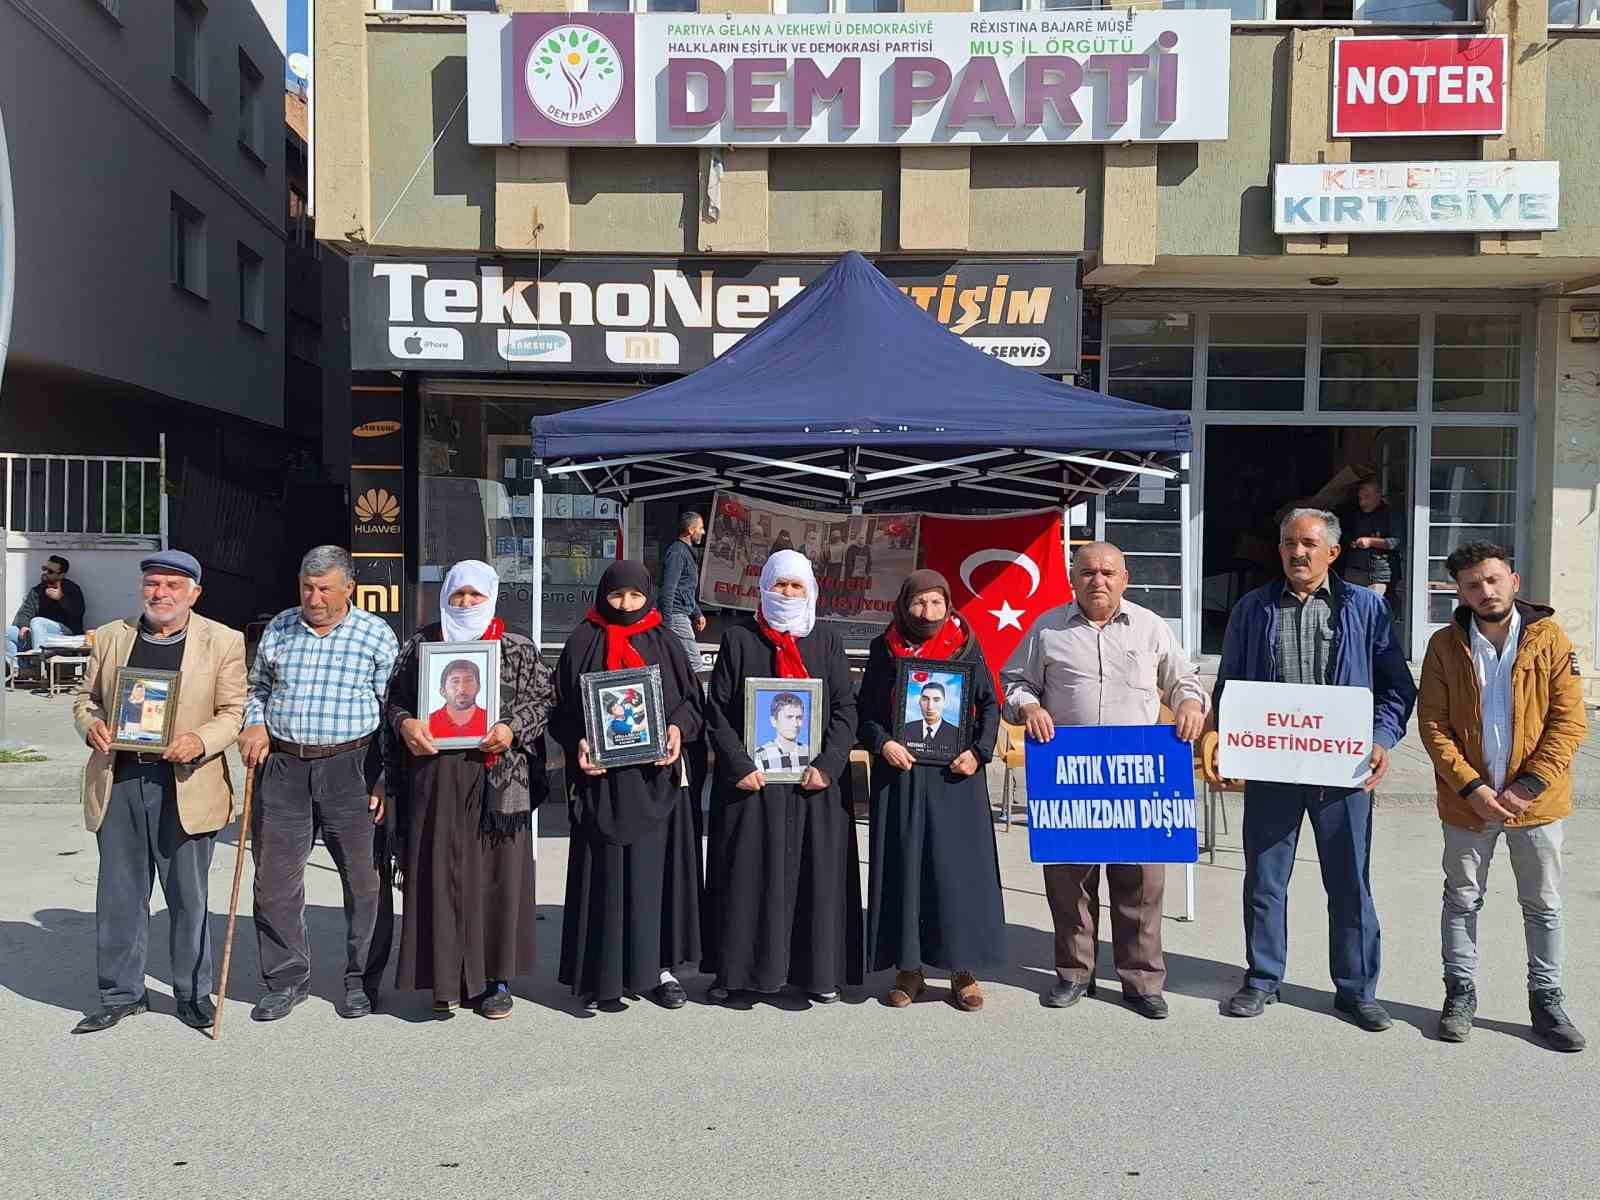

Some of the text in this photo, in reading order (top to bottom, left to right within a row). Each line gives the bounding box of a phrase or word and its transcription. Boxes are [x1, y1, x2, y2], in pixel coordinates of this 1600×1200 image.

[719, 24, 760, 36] GELAN
[765, 24, 774, 35] A
[1041, 18, 1092, 33] BAJARÊ
[668, 39, 933, 55] HALKLARIN EŞİTLİK VE DEMOKRASİ PARTİSİ
[970, 36, 1133, 57] MUŞ İL ÖRGÜTÜ
[668, 30, 1178, 129] DEM PARTİ
[1346, 66, 1495, 104] NOTER
[547, 103, 603, 121] DEM PARTİ
[1283, 190, 1551, 224] KIRTASİYE
[990, 343, 1046, 358] SERVİS
[354, 525, 400, 534] HUAWEI
[1266, 712, 1323, 729] EVLAT
[1227, 731, 1365, 755] NÖBETİNDEYİZ
[1056, 754, 1165, 785] ARTIK YETER !
[1029, 791, 1196, 838] YAKAMIZDAN DÜŞÜN
